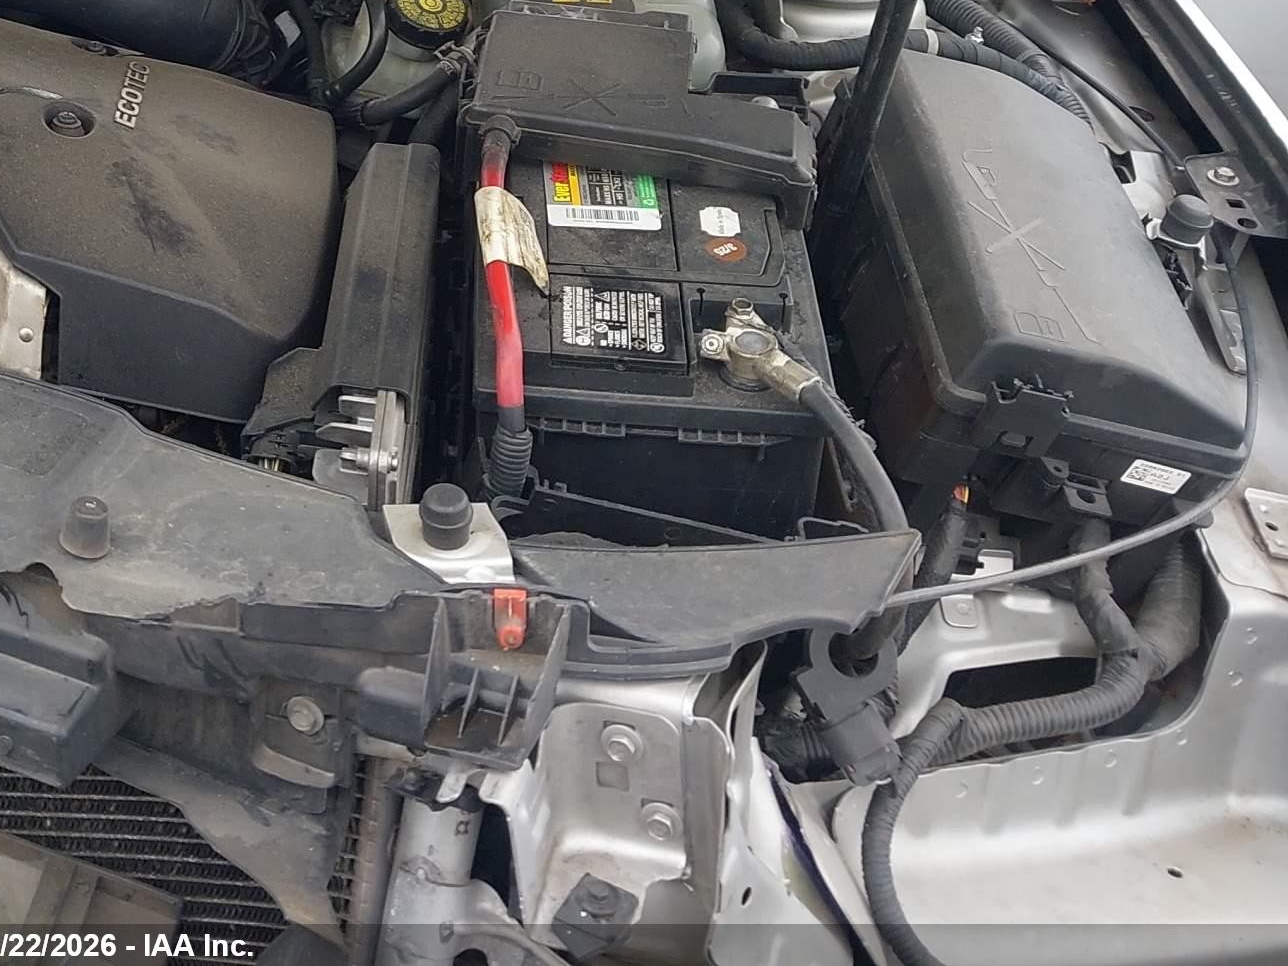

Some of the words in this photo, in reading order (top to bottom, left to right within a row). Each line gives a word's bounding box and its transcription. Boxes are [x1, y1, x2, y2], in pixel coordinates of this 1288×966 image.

[114, 61, 151, 129] ECOTEC
[562, 285, 573, 311] POISON
[562, 311, 573, 338] DANGER
